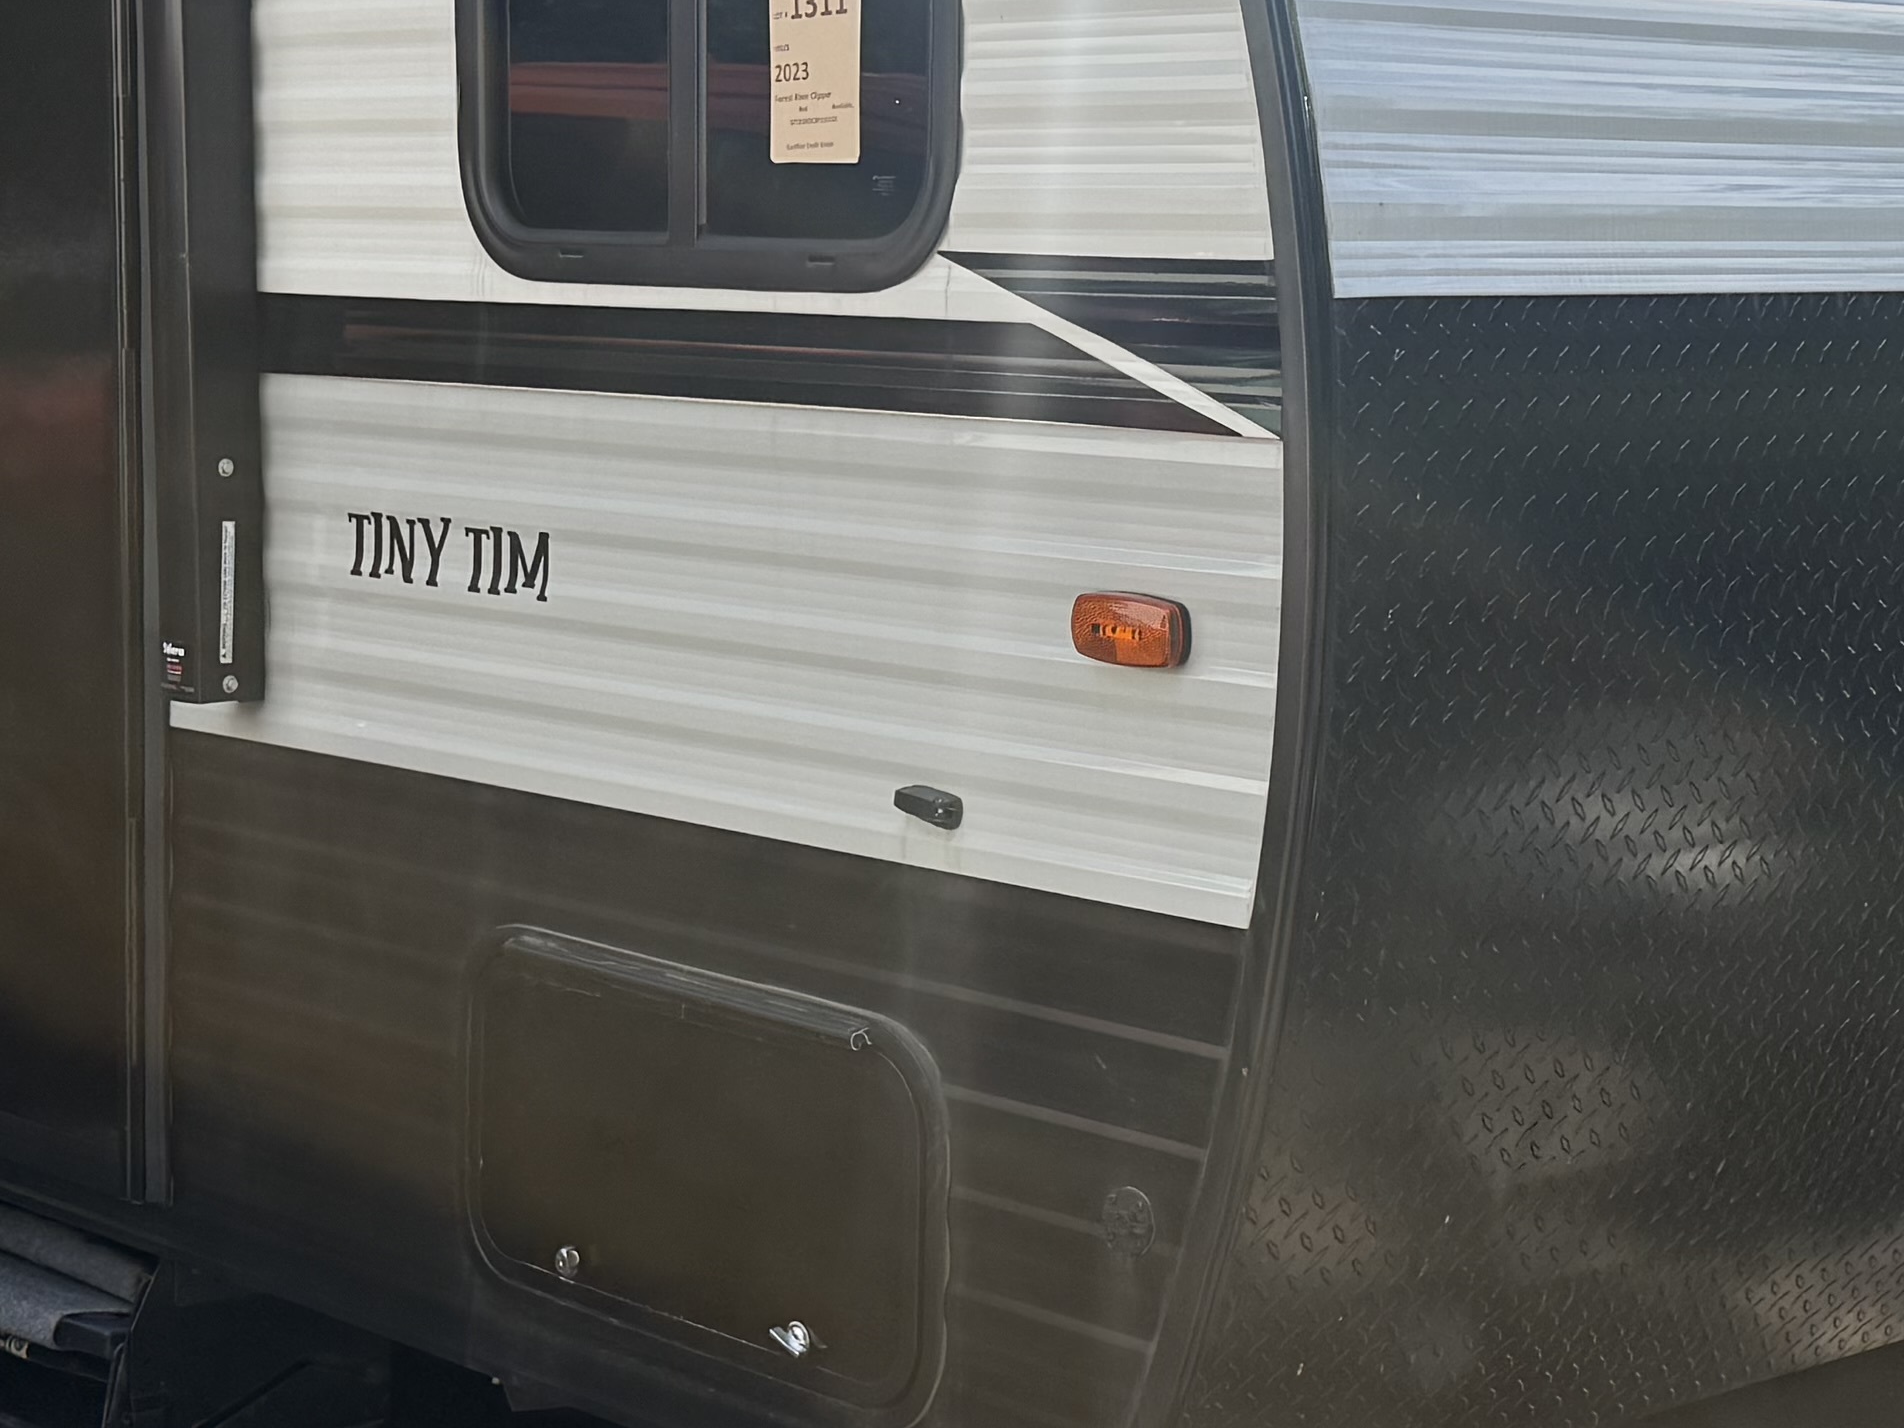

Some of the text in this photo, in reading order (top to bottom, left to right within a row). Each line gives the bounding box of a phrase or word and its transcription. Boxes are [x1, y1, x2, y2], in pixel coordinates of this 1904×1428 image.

[774, 61, 810, 83] 2023
[347, 511, 550, 602] TINY TIM
